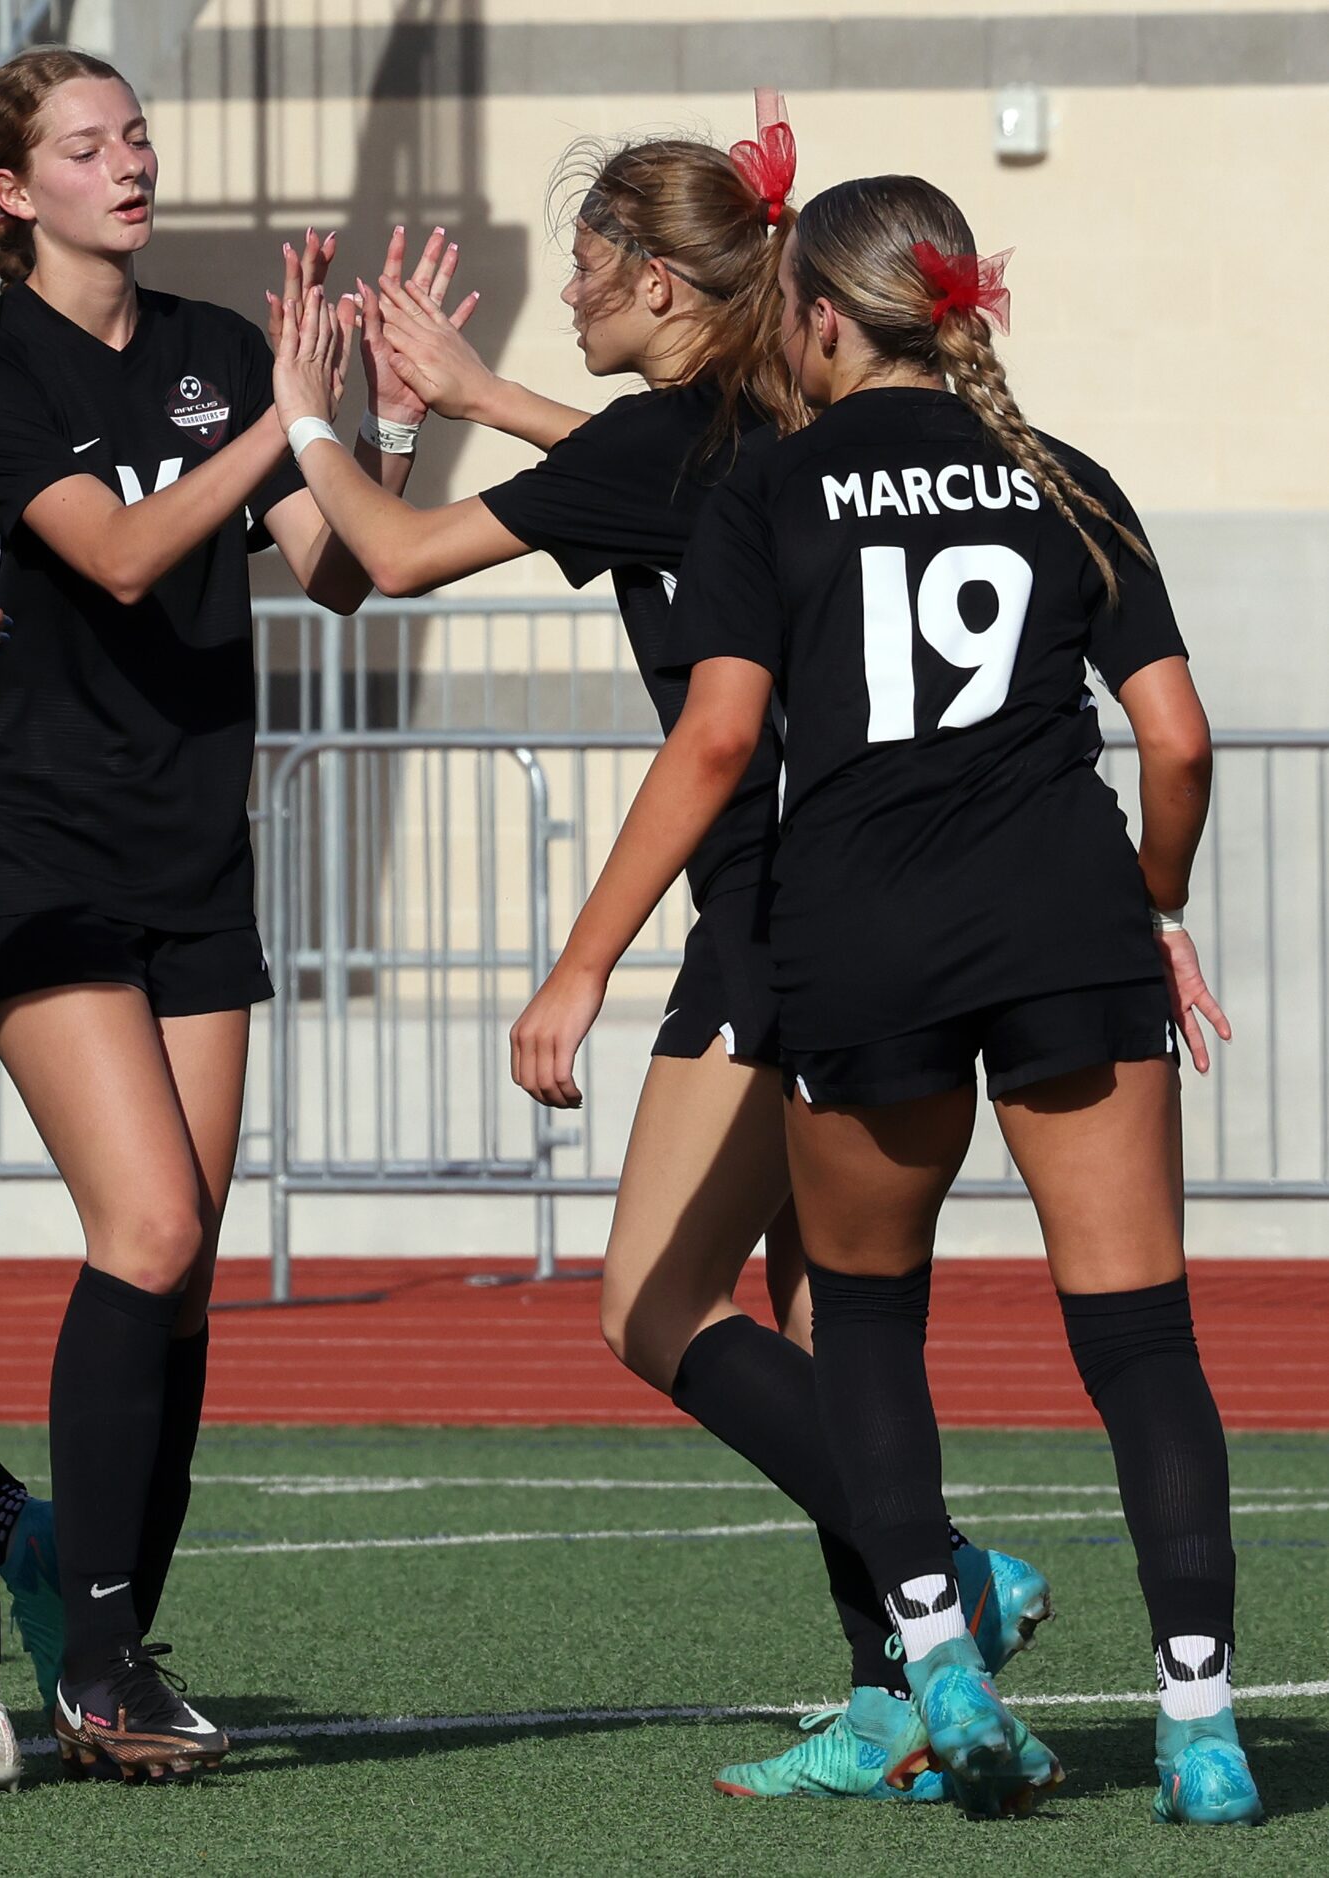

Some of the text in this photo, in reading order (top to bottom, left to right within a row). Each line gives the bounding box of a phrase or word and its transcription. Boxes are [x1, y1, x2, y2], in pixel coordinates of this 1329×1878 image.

[174, 400, 218, 415] MARCUS
[821, 464, 1041, 520] MARCUS
[860, 544, 1034, 743] 19
